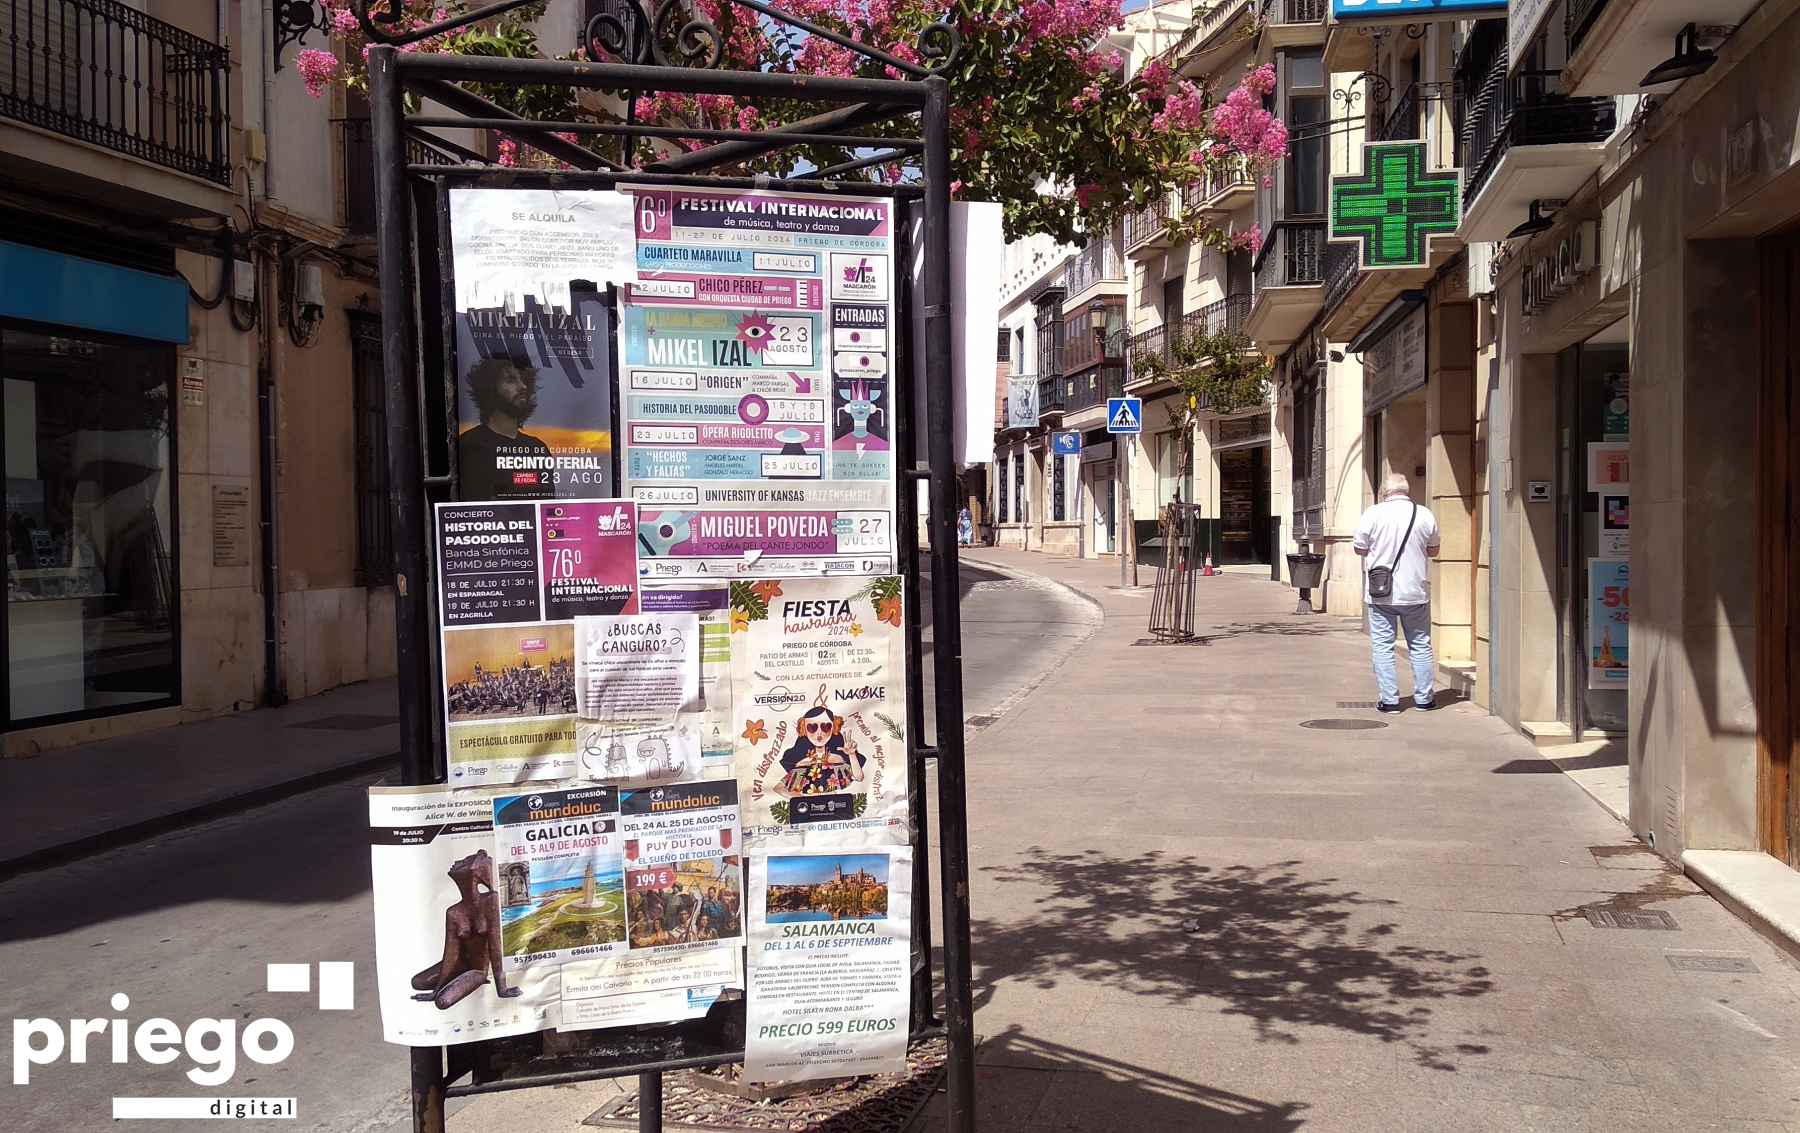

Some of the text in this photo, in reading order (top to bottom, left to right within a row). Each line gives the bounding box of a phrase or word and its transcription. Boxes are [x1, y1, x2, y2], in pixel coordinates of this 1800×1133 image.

[680, 198, 884, 220] FESTIVAL INTERNACIONAL
[512, 212, 576, 223] SE ALQUILA
[724, 217, 840, 232] de música, teatro y danza
[731, 234, 760, 242] JULIO
[644, 246, 811, 268] CUARTETO MARAVILLA JULIO
[653, 276, 763, 294] JULIO CHICO PÉREZ
[865, 275, 876, 283] 24
[699, 294, 792, 306] CON ORQUESTA CIUDAD PRIEGO
[836, 308, 884, 322] ENTRADAS
[648, 326, 808, 367] MIKEL IZAL 23
[770, 344, 808, 353] AGOSTO
[654, 376, 692, 386] JULIO
[642, 402, 737, 416] HISTORIA DEL PASODOBLE
[780, 412, 816, 421] JULIO
[636, 424, 774, 440] 23 JULIO ÓPERA RIGOLETTO
[496, 446, 546, 454] PRIEGO DE
[496, 456, 601, 470] RECINTO FERIAL
[646, 462, 818, 478] Y JULIO
[541, 472, 560, 484] 23
[570, 472, 602, 484] AGO
[640, 490, 805, 502] 26 JULIO UNIVERSITY OF KANSAS
[444, 510, 494, 520] CONCIERTO
[444, 520, 534, 532] HISTORIA DEL
[620, 522, 632, 530] 24
[701, 516, 883, 538] MIGUEL POVEDA 27
[446, 534, 525, 546] PASODOBLE
[844, 536, 884, 546] JULIO
[446, 546, 530, 558] Banda Sinfónica
[446, 558, 534, 570] EMMD de Priego
[474, 580, 498, 588] JULIO
[501, 579, 525, 587] 21:30
[551, 577, 600, 586] FESTIVAL
[460, 590, 504, 598] ESPARRAGAL
[552, 584, 634, 596] INTERNACIONAL
[586, 594, 604, 602] teatro
[460, 600, 526, 610] DE JULIO 21:30
[782, 600, 852, 618] FIESTA
[607, 622, 662, 638] ¿BUSCAS
[784, 611, 857, 637] hawaiana
[828, 624, 849, 636] 2024
[602, 638, 668, 654] CANGURO?
[782, 642, 808, 650] PRIEGO
[820, 640, 852, 648] CÓRDOBA
[818, 650, 828, 659] 02
[778, 660, 804, 668] CASTILLO
[776, 674, 790, 682] CON
[806, 672, 852, 680] ACTUACIONES
[460, 732, 562, 749] ESPECTÁCULO GRATUITO PARA
[567, 790, 606, 800] EXCURSIÓN
[392, 803, 436, 812] Inauguración
[650, 794, 720, 812] mundoluc
[426, 809, 467, 820] Alice de
[528, 802, 602, 820] mundoluc
[624, 813, 736, 832] DEL 24 AL 25 DE AGOSTO
[818, 822, 862, 832] OBJETIVOS
[526, 824, 590, 842] GALICIA
[511, 836, 608, 856] DEL 5 DE AGOSTO
[646, 836, 712, 852] PUY DU FOU
[650, 849, 724, 863] SUEÑO DE TOLEDO
[635, 871, 669, 886] 199 €
[782, 922, 876, 938] SALAMANCA
[764, 936, 894, 952] DEL AL 6 DE SEPTIEMBRE
[616, 956, 682, 970] Precios Populares
[602, 980, 632, 990] Calvario
[782, 1008, 803, 1016] HOTEL
[759, 1018, 897, 1038] PRECIO 599 EUROS
